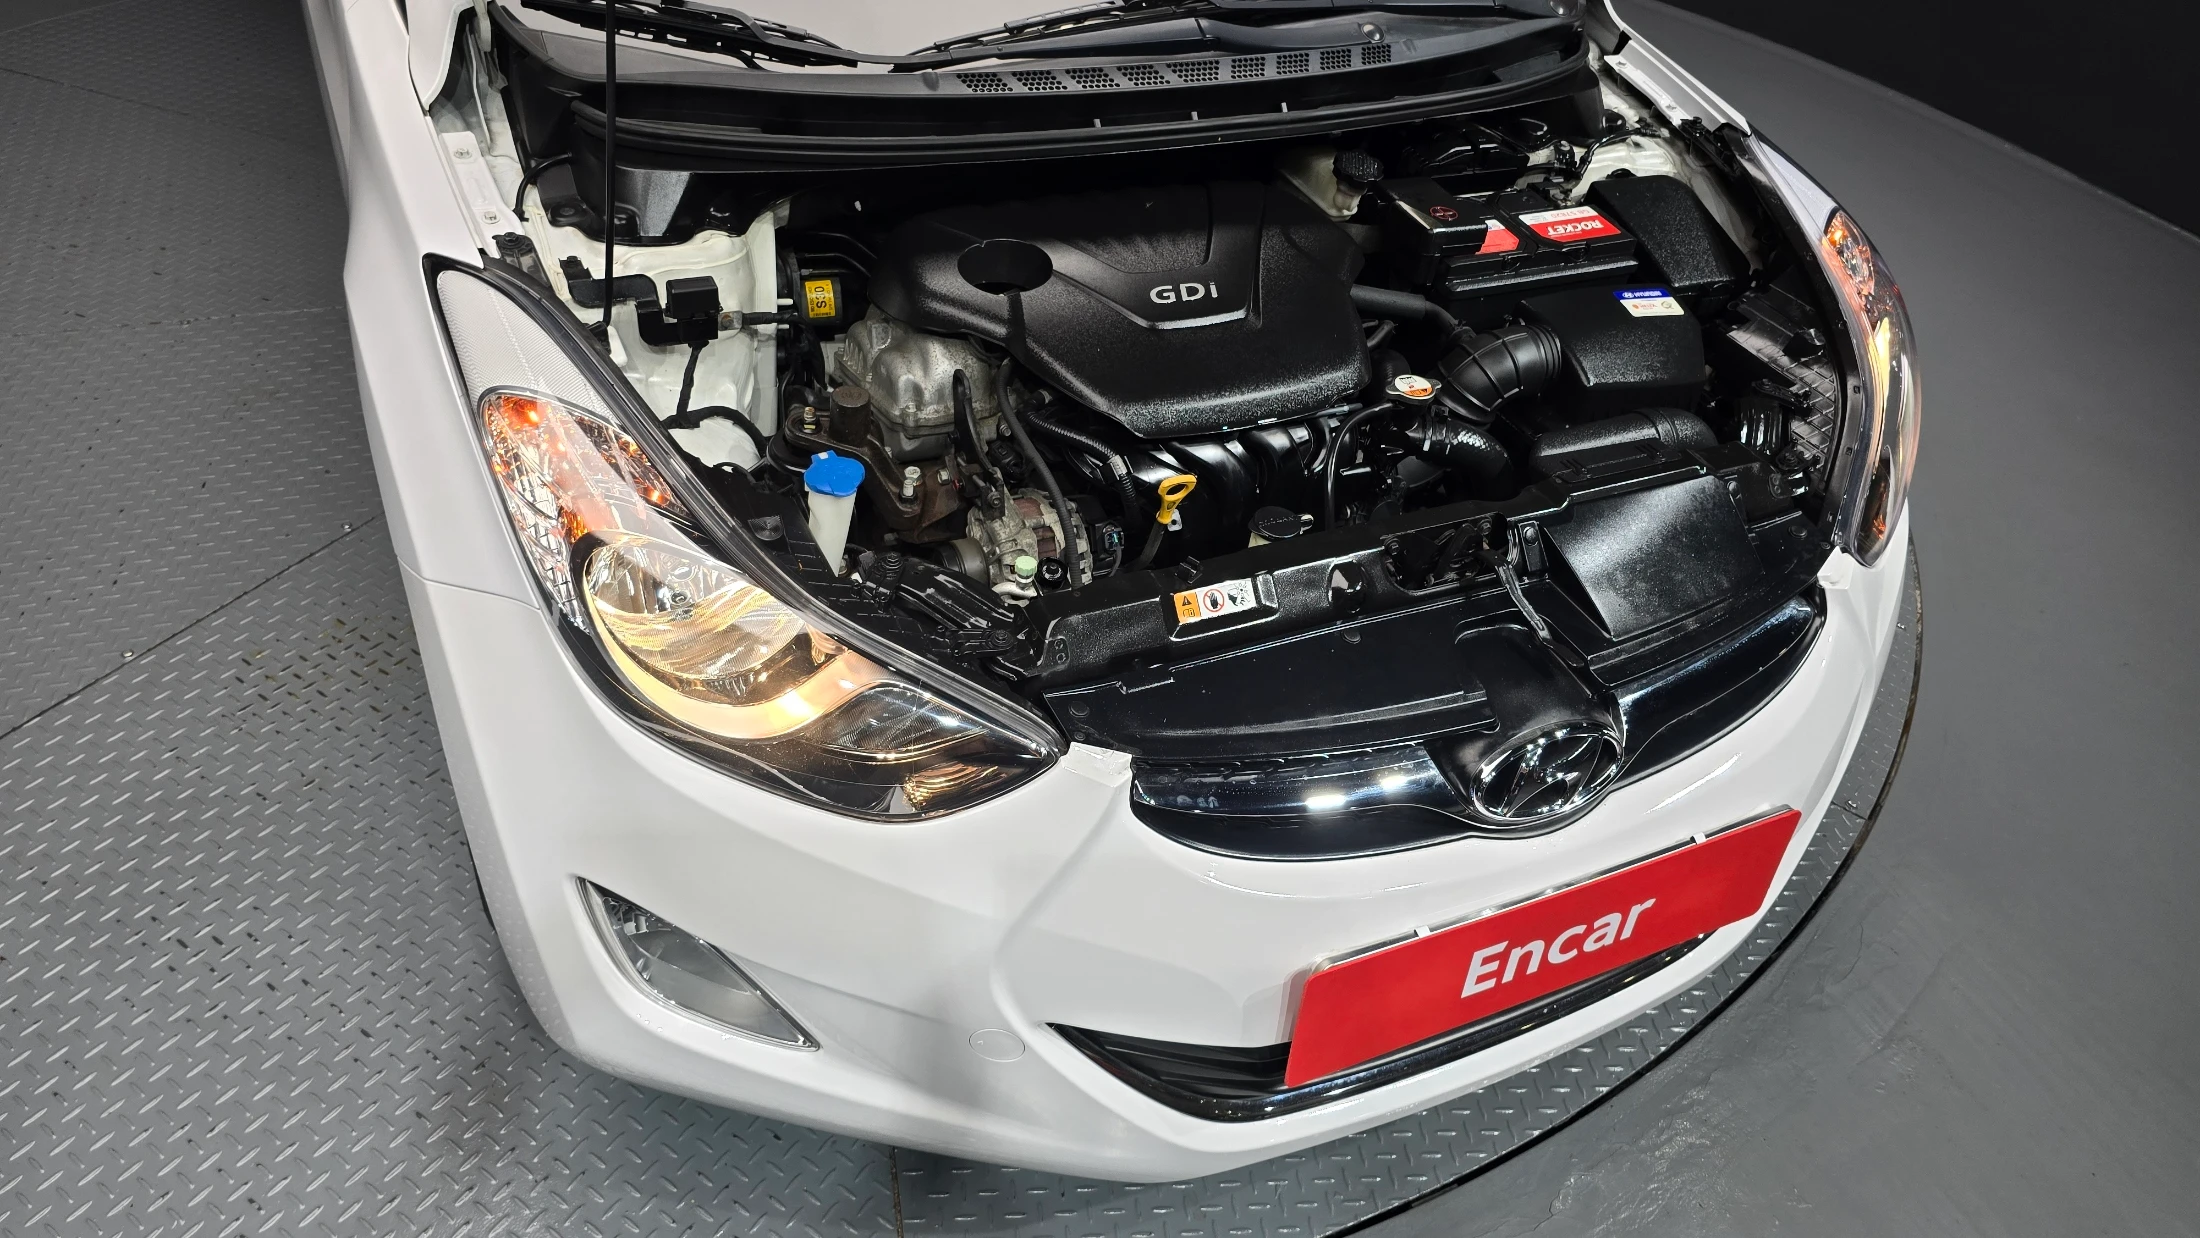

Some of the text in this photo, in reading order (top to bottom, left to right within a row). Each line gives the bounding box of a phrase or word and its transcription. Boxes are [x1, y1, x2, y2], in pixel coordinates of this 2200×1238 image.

[1547, 220, 1604, 235] ROCKET
[1149, 281, 1218, 303] GDi
[1461, 898, 1657, 999] Encar
